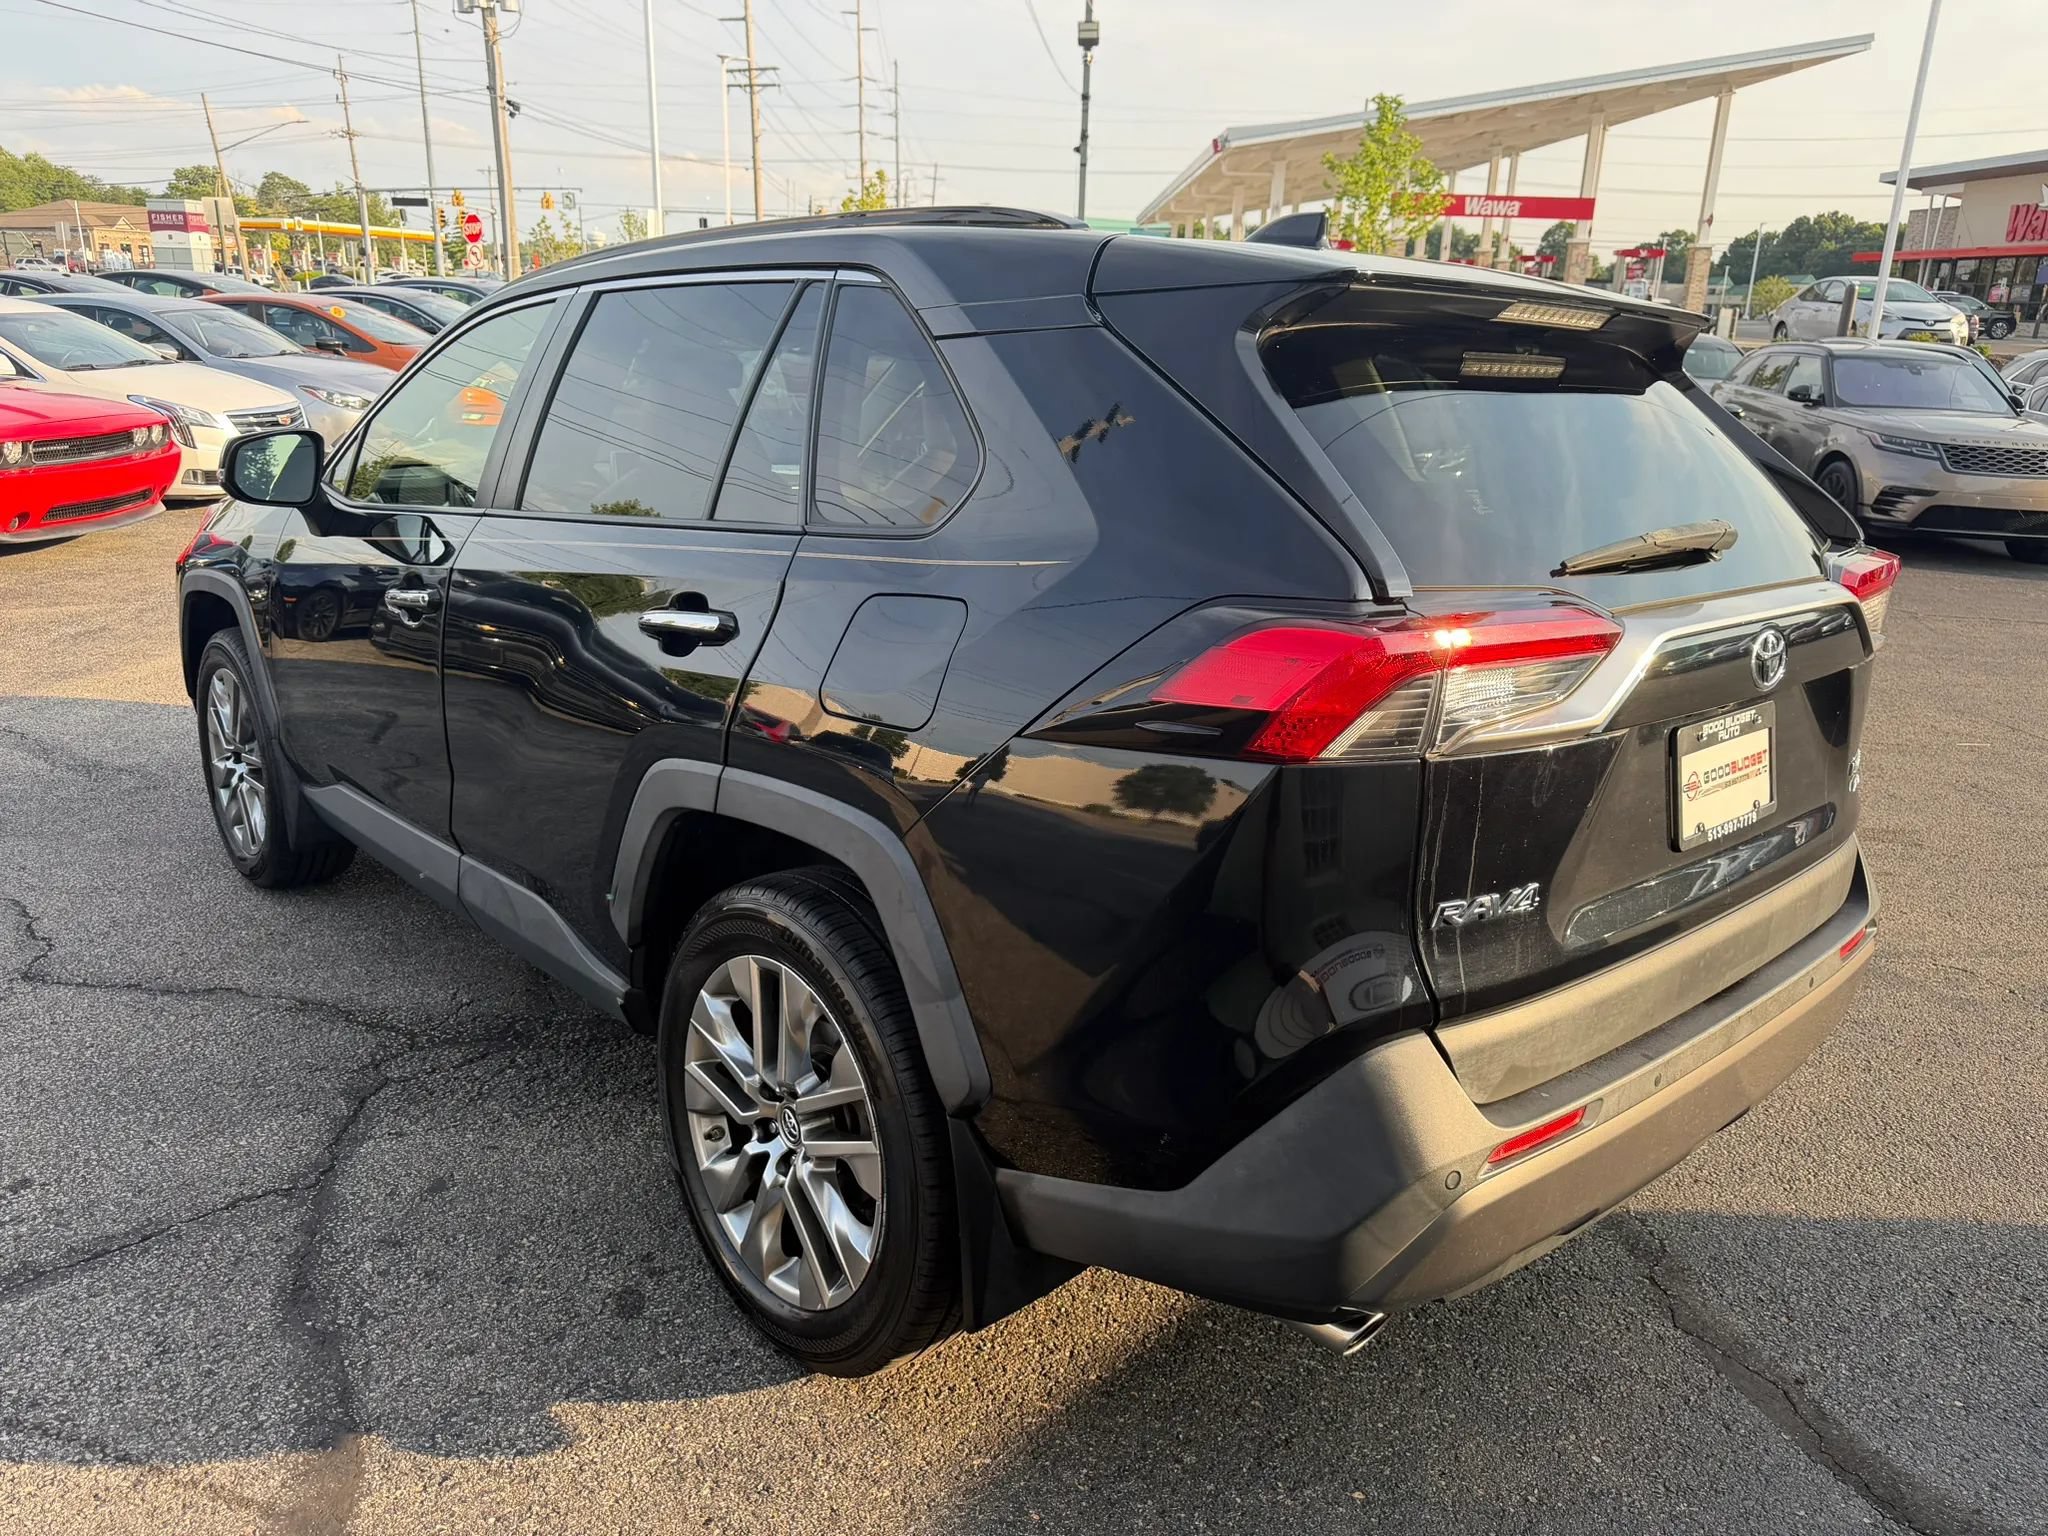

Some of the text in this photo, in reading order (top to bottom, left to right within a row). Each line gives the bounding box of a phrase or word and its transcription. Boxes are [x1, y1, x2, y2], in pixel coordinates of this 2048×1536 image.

[1464, 196, 1521, 216] Wawa
[151, 213, 184, 222] FISHER
[464, 222, 482, 236] STOP
[1702, 709, 1757, 736] GOOD BUDGET
[1718, 725, 1740, 741] AUTO
[1431, 882, 1540, 929] RAV4
